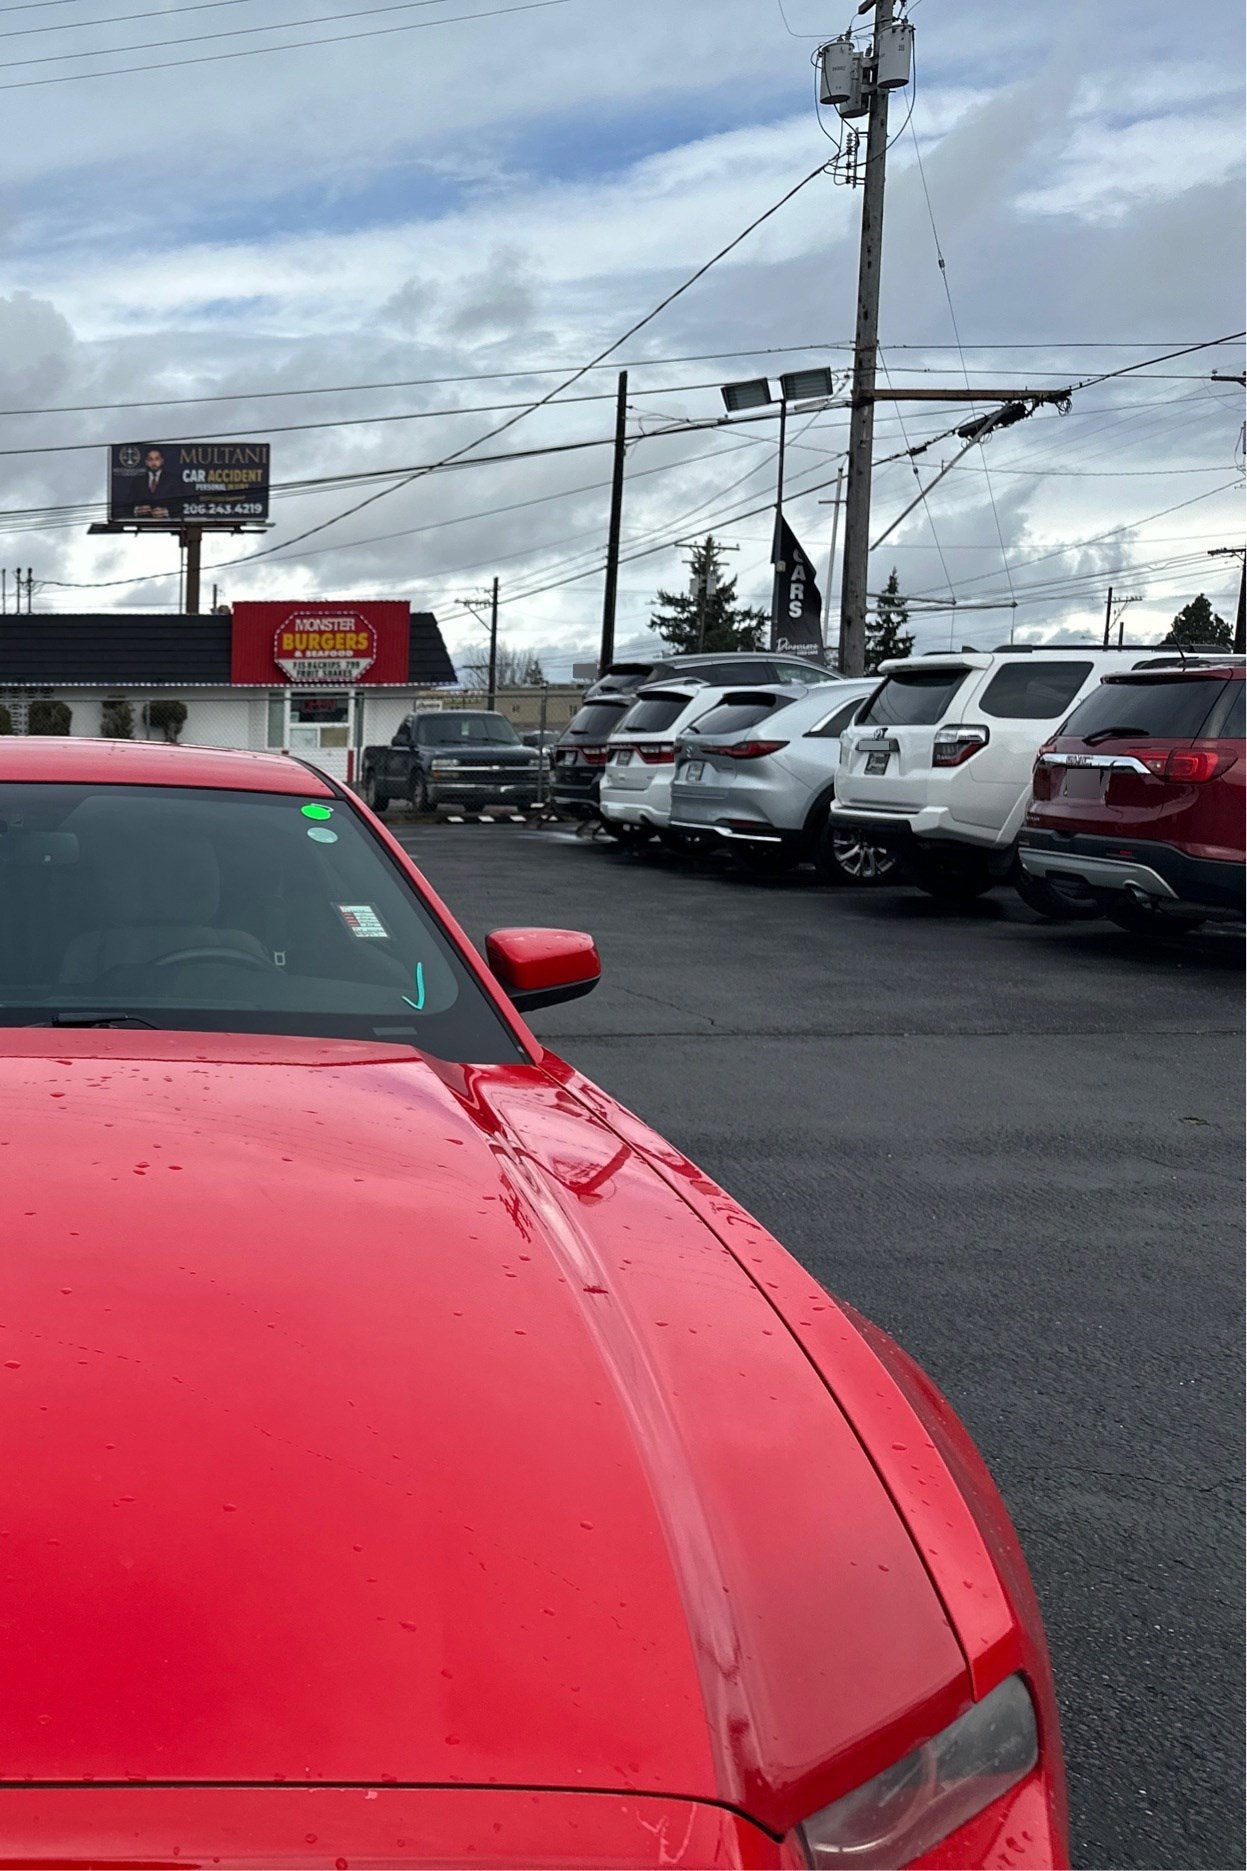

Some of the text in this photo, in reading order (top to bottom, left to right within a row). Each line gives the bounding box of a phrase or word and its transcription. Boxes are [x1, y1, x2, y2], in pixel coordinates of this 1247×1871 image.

[180, 447, 268, 464] MULTANI
[182, 469, 263, 483] CAR ACCIDENT
[182, 503, 263, 515] 206.243.4219
[789, 548, 806, 618] CARS
[295, 618, 356, 631] MONSTER
[282, 632, 369, 650] BURGERS
